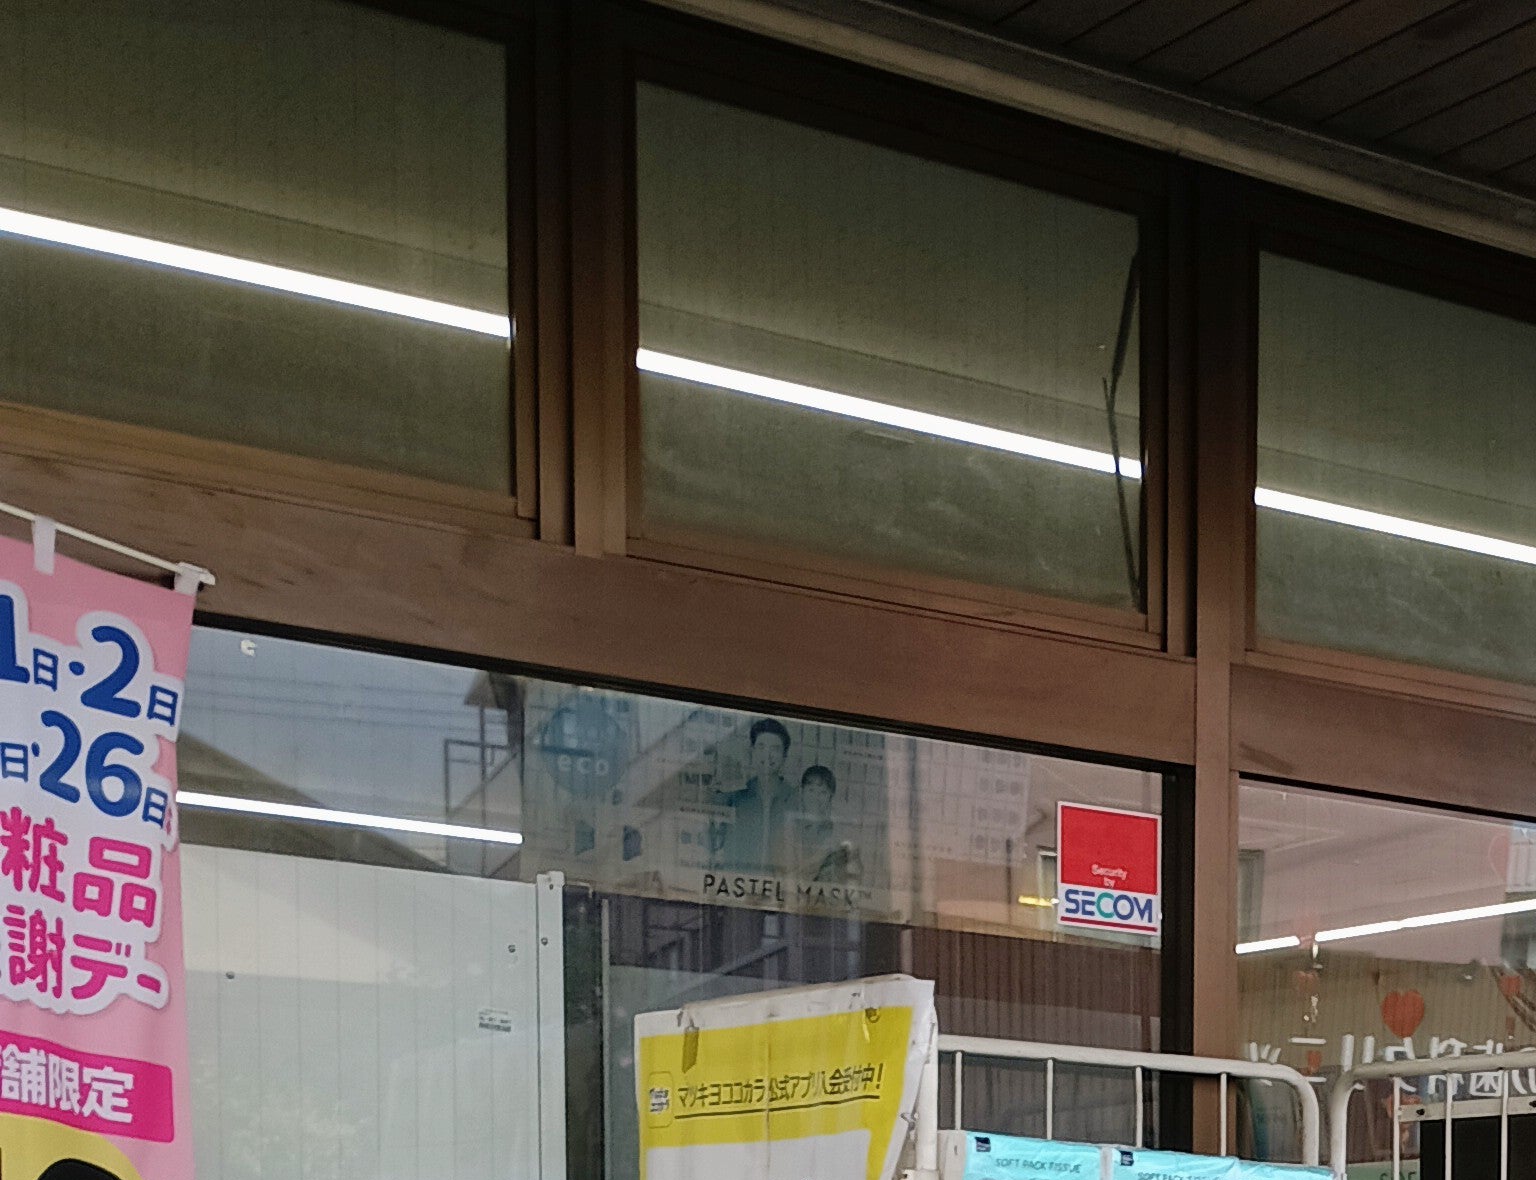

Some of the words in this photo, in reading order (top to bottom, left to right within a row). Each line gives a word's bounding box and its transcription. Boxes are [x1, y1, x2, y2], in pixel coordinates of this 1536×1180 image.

[0, 806, 157, 929] 粧品
[1064, 889, 1153, 924] SECOM
[6, 905, 160, 1000] 謝デー
[0, 1043, 134, 1124] 舗限定
